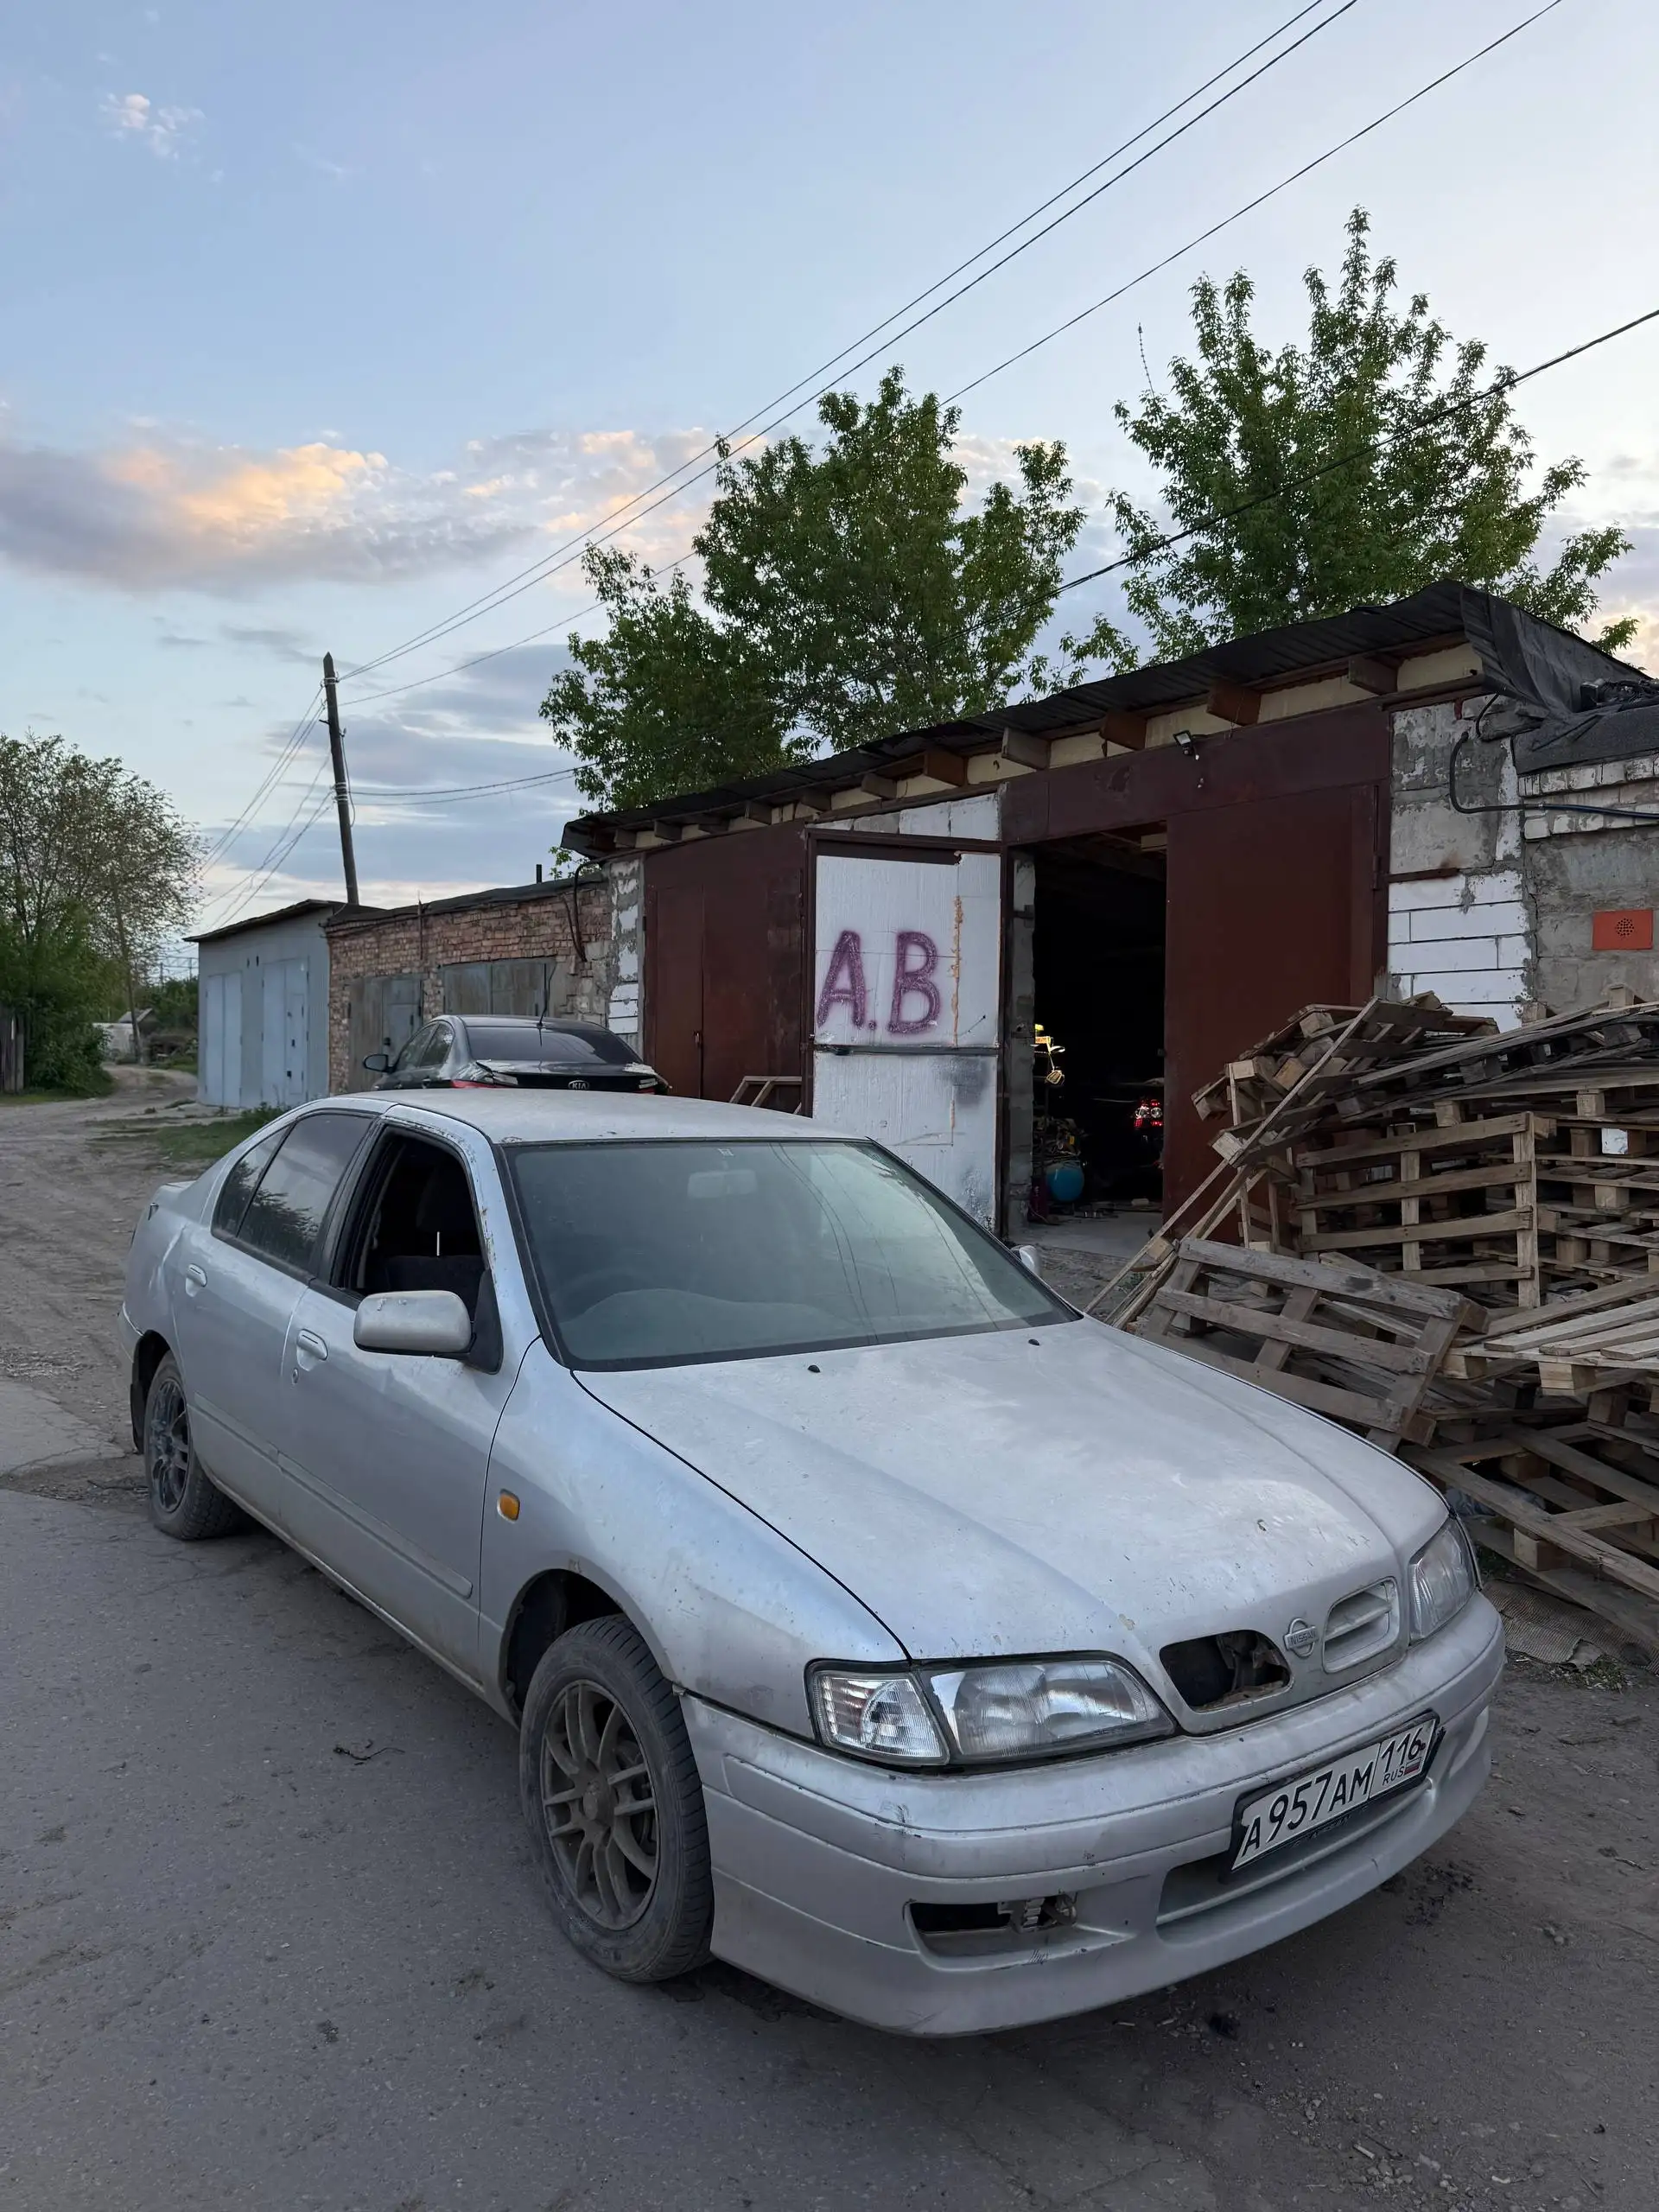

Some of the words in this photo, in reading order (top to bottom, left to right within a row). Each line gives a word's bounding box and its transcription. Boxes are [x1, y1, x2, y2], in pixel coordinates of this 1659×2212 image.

[1290, 1629, 1316, 1645] NISSAN
[1382, 1727, 1424, 1772] 116
[1382, 1766, 1405, 1786] RUS
